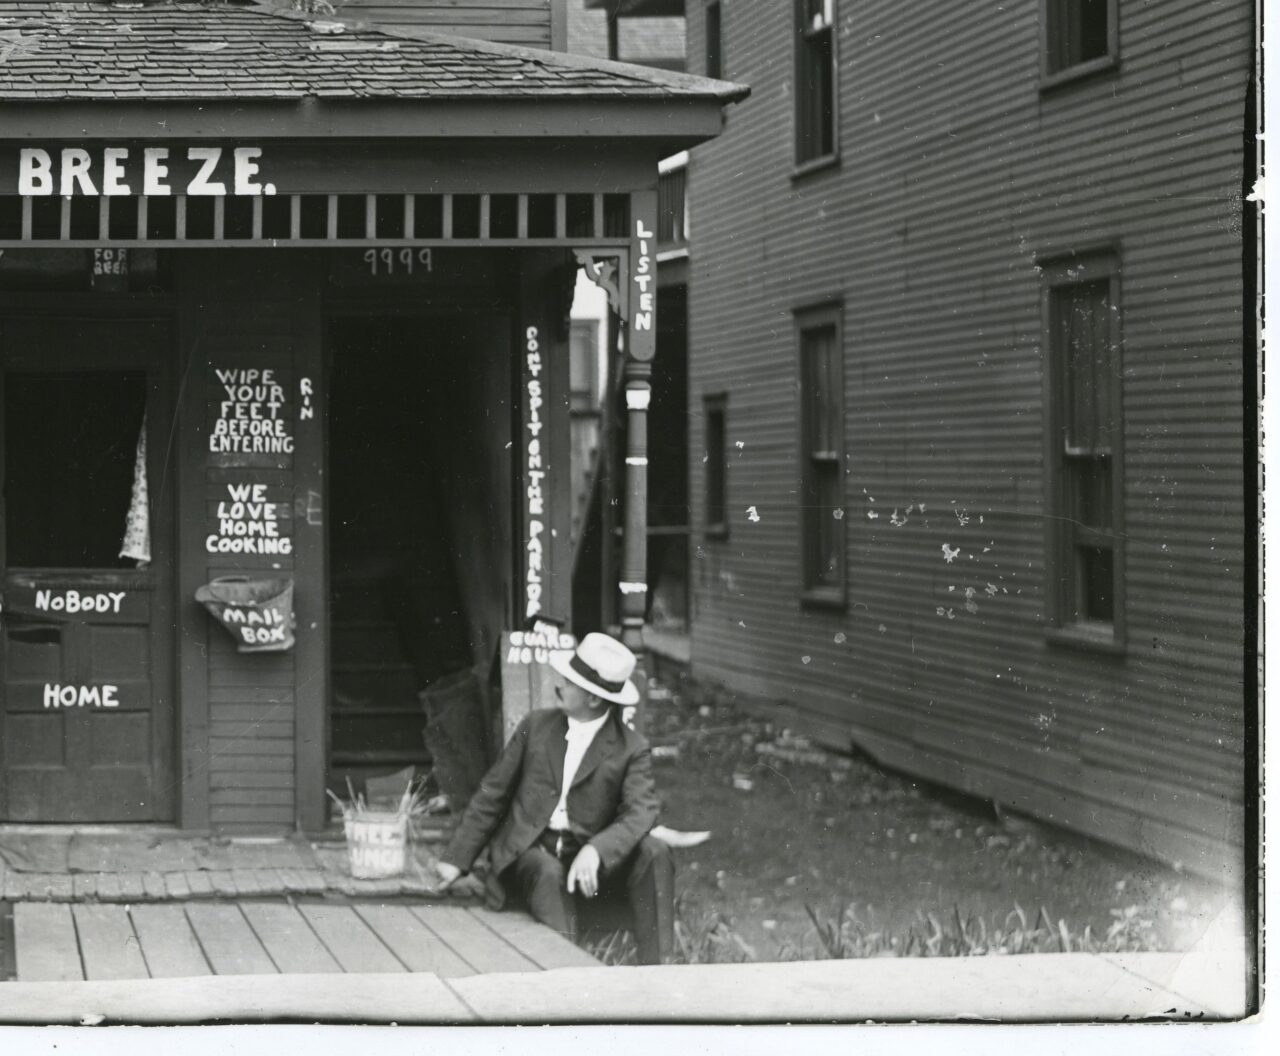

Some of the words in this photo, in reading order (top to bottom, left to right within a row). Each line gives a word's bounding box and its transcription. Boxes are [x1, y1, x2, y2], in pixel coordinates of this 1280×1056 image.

[19, 148, 276, 200] BREEZE.
[634, 220, 653, 330] LISTEN
[216, 369, 277, 385] WIPE
[224, 385, 284, 403] YOUR
[222, 402, 280, 419] FEET
[214, 419, 286, 437] BEFORE
[210, 436, 293, 453] ENTERING
[228, 484, 267, 502] WE
[218, 502, 276, 521] LOVE
[219, 520, 278, 537] HOME
[206, 535, 292, 554] COOKING
[224, 608, 284, 625] MAIL
[241, 624, 287, 644] BOX
[44, 684, 118, 707] HOME
